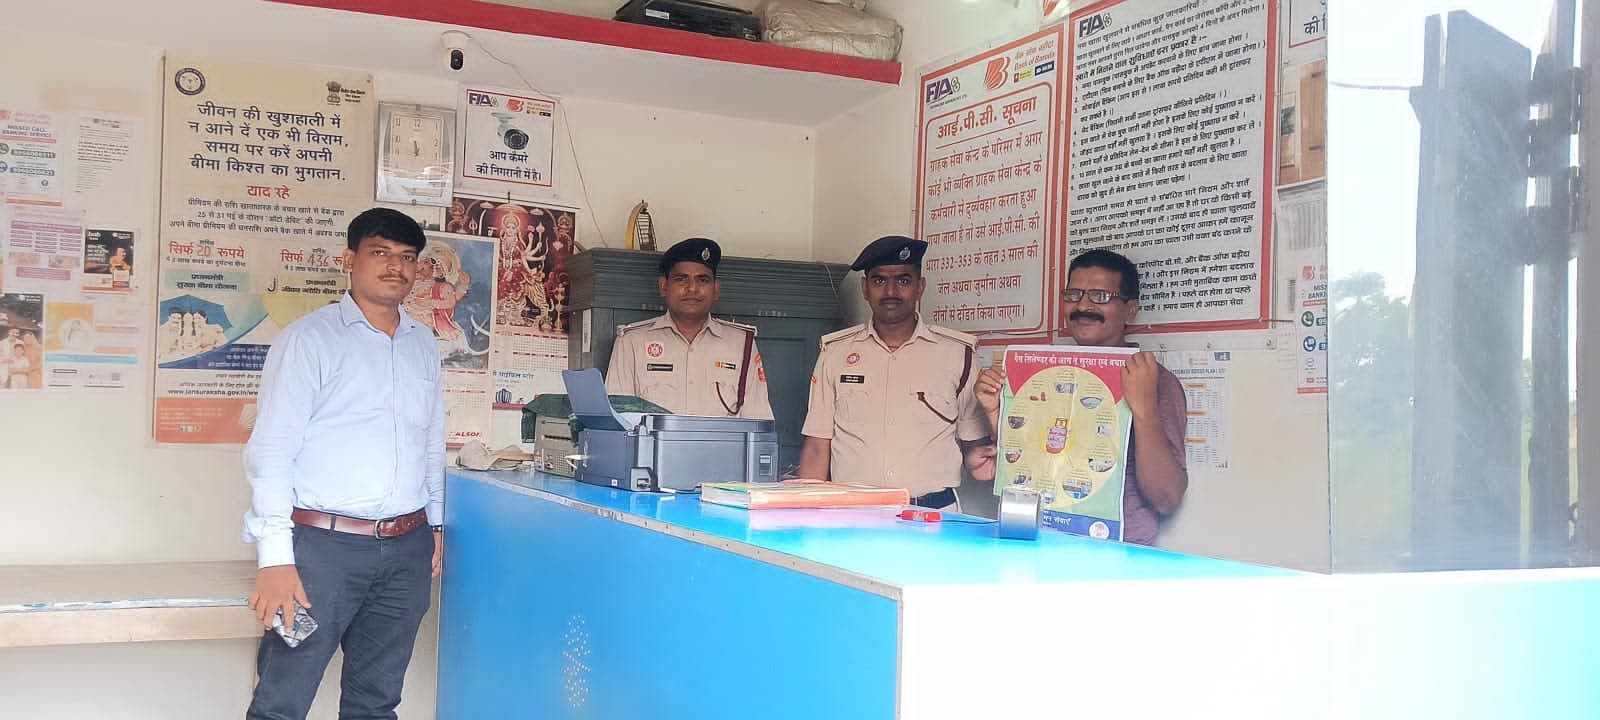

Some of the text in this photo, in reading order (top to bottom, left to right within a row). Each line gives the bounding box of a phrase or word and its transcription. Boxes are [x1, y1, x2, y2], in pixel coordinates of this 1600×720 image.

[1080, 14, 1105, 37] FIA
[1304, 16, 1320, 35] की
[468, 92, 492, 106] FIA
[926, 78, 954, 102] FIA
[197, 101, 341, 128] जीवन की खुशहाली में
[938, 104, 997, 138] आई.पी.सी.
[1002, 96, 1038, 126] सूचना
[188, 122, 199, 132] न
[205, 121, 234, 136] आने
[240, 122, 250, 138] दें
[256, 128, 280, 140] एक
[285, 127, 300, 142] भी
[204, 141, 332, 162] समय पर करें अपनी
[489, 150, 506, 160] आप
[930, 157, 948, 172] ग्राहक
[950, 150, 962, 168] सेवा
[965, 146, 980, 162] केन्द्र
[982, 140, 990, 158] के
[991, 138, 1013, 155] परिसर
[1024, 132, 1043, 147] अगर
[189, 154, 220, 172] बीमा
[226, 158, 264, 174] किश्त
[271, 164, 288, 176] का
[476, 163, 488, 174] की
[490, 164, 522, 178] निगरानी
[523, 167, 531, 180] में
[928, 154, 1042, 198] कोई भी व्यक्ति ग्राहक सेवा केन्द्र के
[246, 184, 290, 199] याद रहे
[930, 202, 956, 220] कर्मचारी
[958, 200, 964, 216] से
[998, 192, 1018, 208] करता
[1020, 188, 1037, 208] हुआ
[942, 230, 956, 244] जाता
[959, 224, 964, 244] है
[966, 222, 973, 240] तो
[975, 221, 986, 239] उसे
[1028, 211, 1040, 231] की
[168, 241, 194, 256] सिर्फ
[197, 245, 212, 256] 20
[280, 249, 303, 262] सिर्फ
[926, 240, 1038, 272] धारा 332-353 के तहत 3 साल की
[937, 273, 1022, 296] जेल अथवा जुर्माना अथवा
[933, 305, 946, 323] दोनों
[958, 303, 975, 321] दंडित
[977, 303, 995, 320] किया
